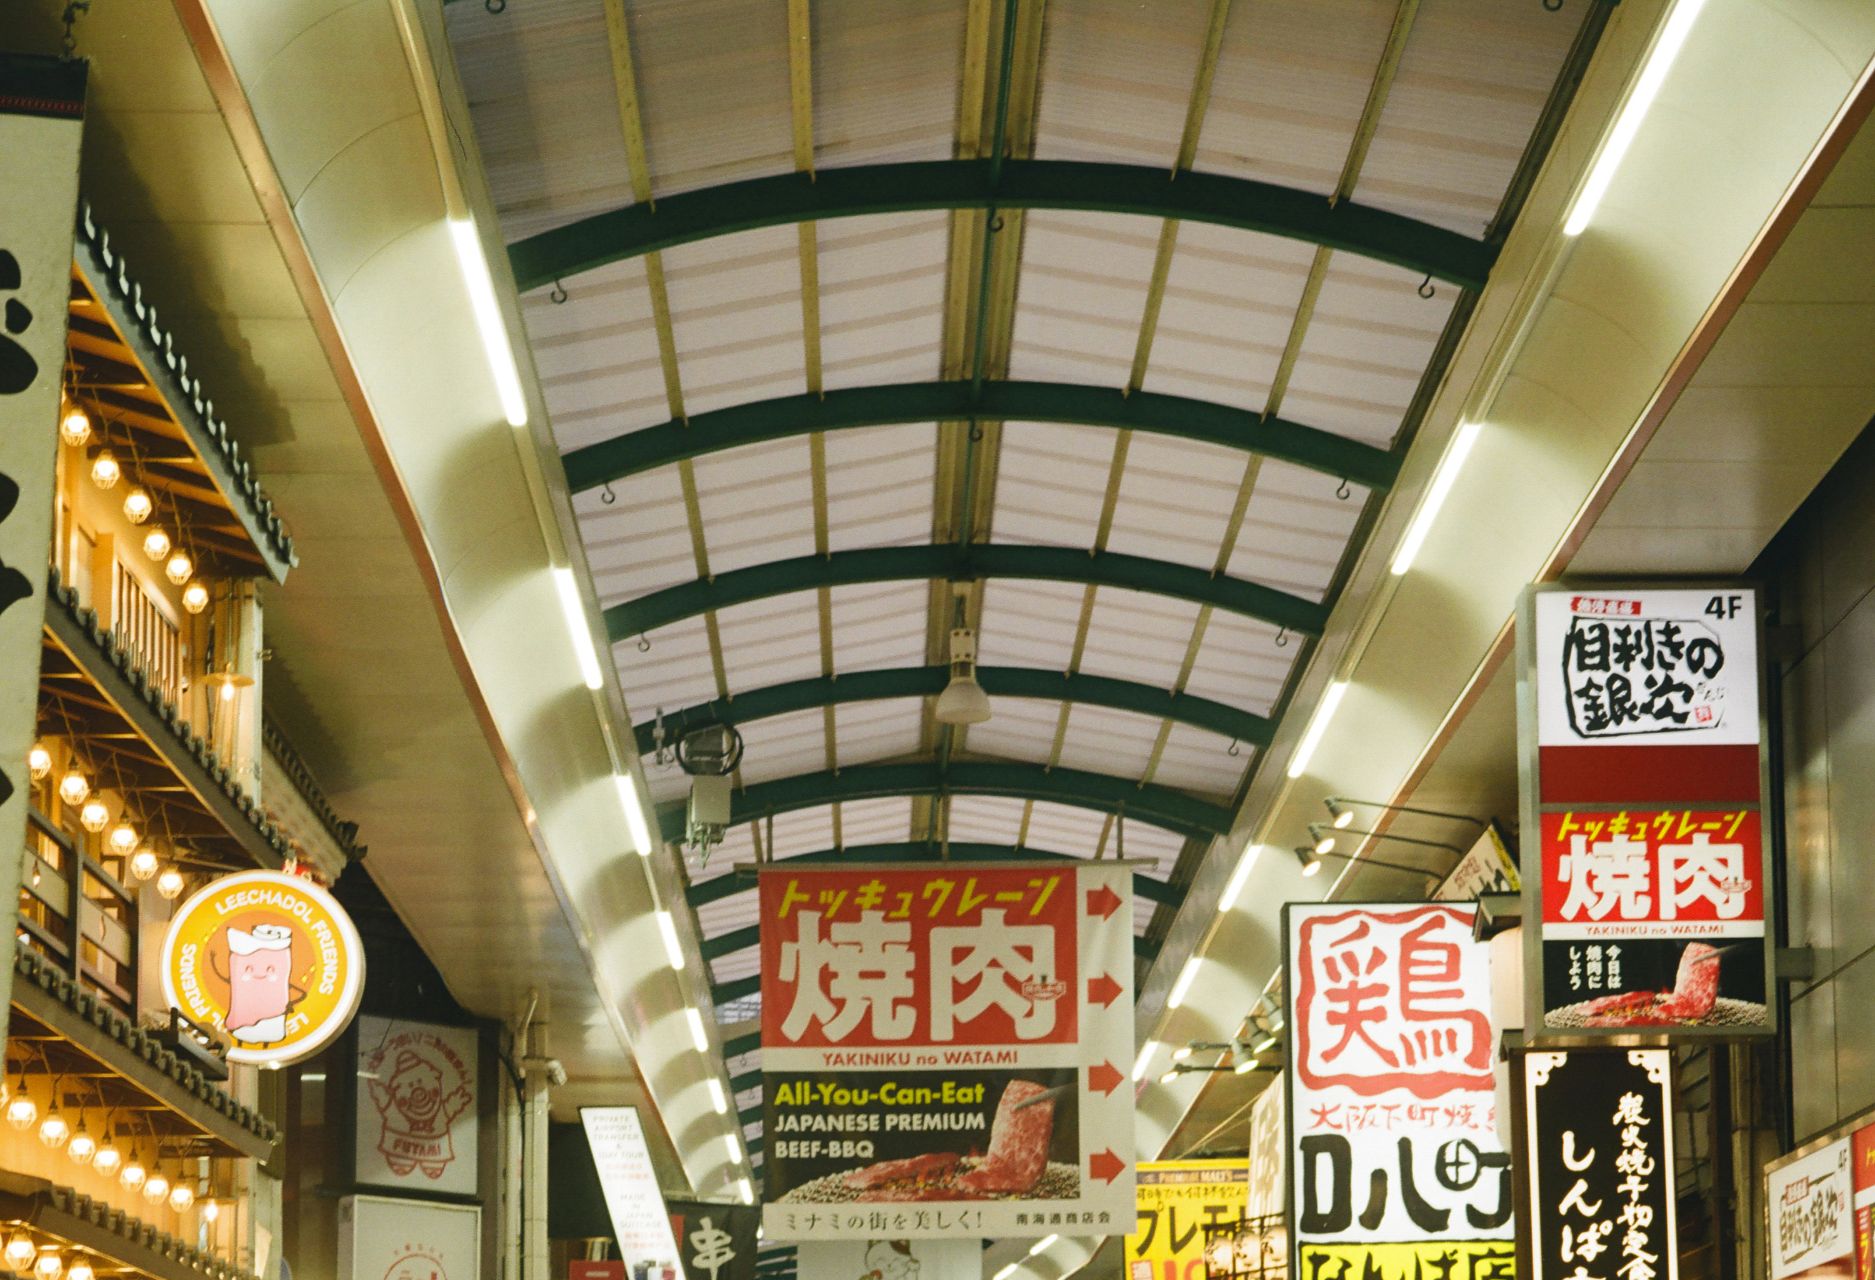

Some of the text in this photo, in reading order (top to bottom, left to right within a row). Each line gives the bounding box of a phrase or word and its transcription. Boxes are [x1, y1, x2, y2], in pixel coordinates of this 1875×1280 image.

[1704, 596, 1743, 620] 4F
[1574, 620, 1724, 679] 目利きの
[1574, 673, 1694, 731] 銀次
[1557, 811, 1747, 841] トッキュウレーン
[778, 876, 1060, 919] トッキュウレーン
[1557, 833, 1746, 921] 焼肉
[215, 889, 338, 996] LEECHADOL FRIENDS
[1585, 926, 1648, 936] YAKINIKU
[1669, 925, 1725, 935] WATAMI
[179, 943, 209, 1018] FRIENDS
[778, 908, 1057, 1043] 焼肉
[1569, 946, 1582, 990] しよう
[1586, 945, 1602, 989] 焼肉に
[1605, 945, 1622, 988] 今日は
[1321, 915, 1492, 1068] 鶏
[822, 1051, 1018, 1066] YAKINIKU no WATAMI
[774, 1081, 985, 1107] All-You-Can-Eat
[774, 1112, 985, 1132] JAPANESE PREMIUM
[774, 1139, 875, 1159] BEEF-BBQ
[1016, 1211, 1111, 1225] 南海通商店会
